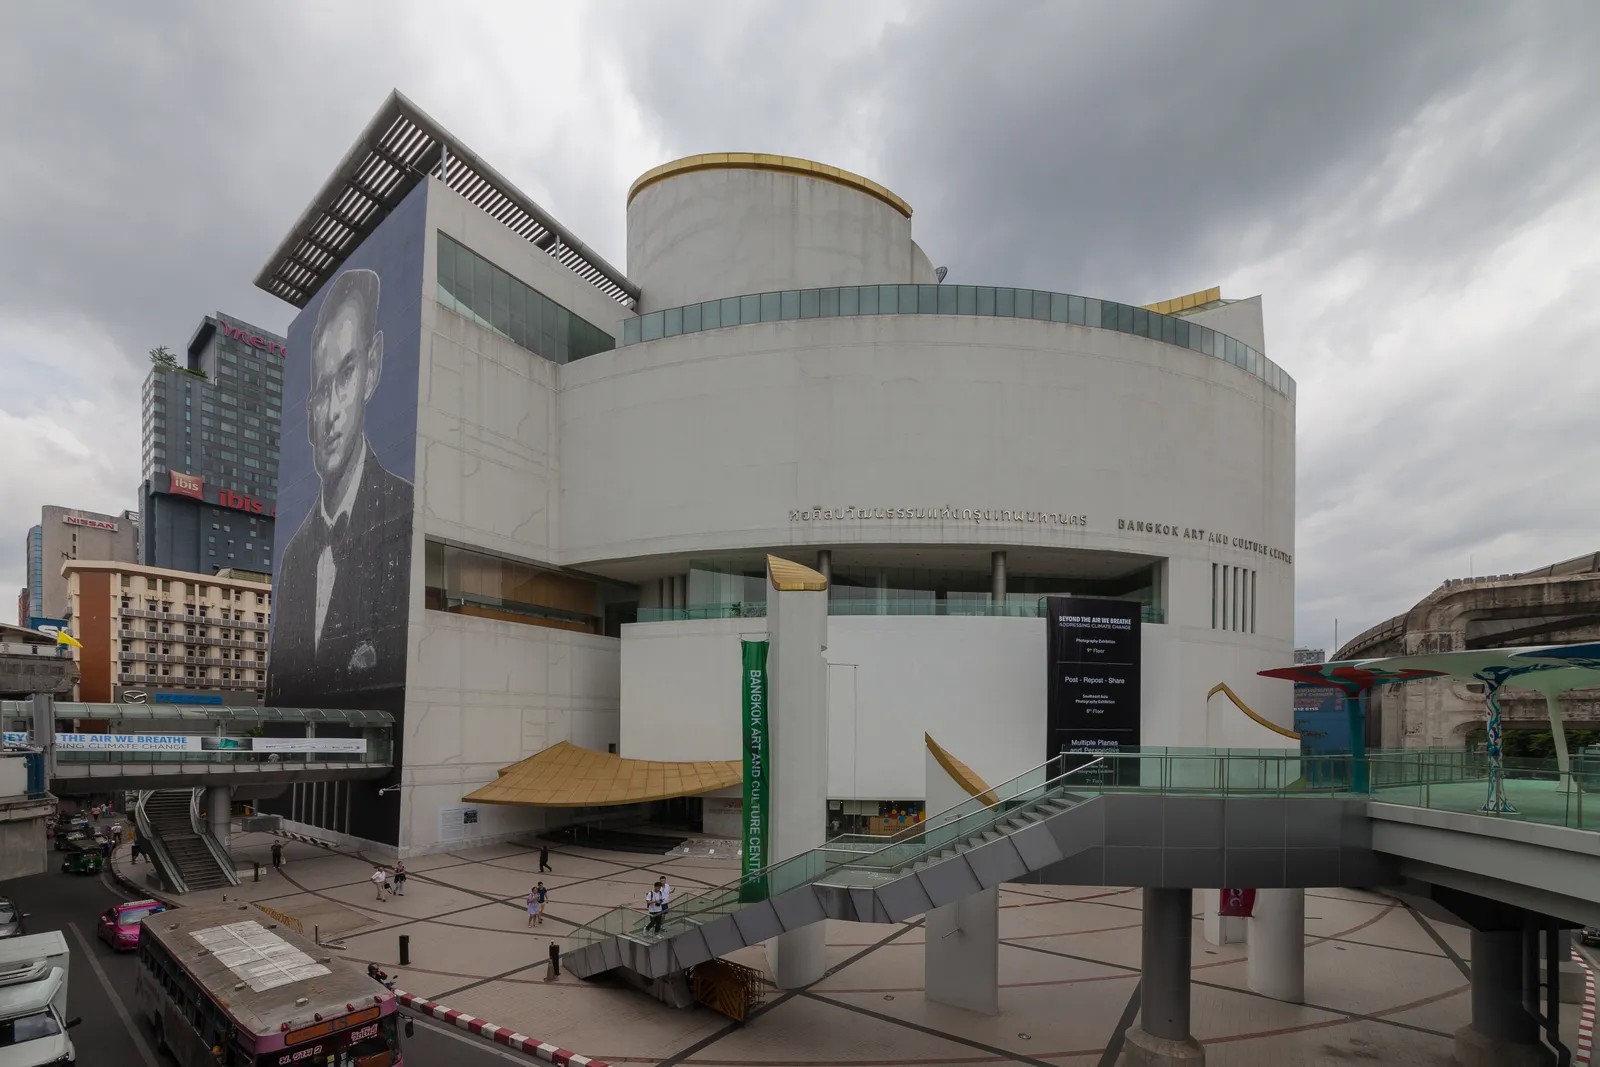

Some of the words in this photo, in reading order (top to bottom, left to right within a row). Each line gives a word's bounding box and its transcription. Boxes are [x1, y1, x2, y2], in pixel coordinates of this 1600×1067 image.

[175, 477, 199, 492] ibis
[220, 489, 263, 514] ibis
[67, 516, 114, 530] NISSAN
[1118, 518, 1178, 537] BANGKOK
[1184, 528, 1204, 541] ART
[1208, 532, 1228, 545] AND
[1232, 537, 1268, 556] CULTURE
[1270, 547, 1292, 565] CENTRE
[750, 670, 761, 726] BANGKOK
[751, 728, 761, 750] ART
[751, 753, 761, 777] AND
[750, 780, 760, 834] CULTURE
[749, 838, 760, 883] CENTRE
